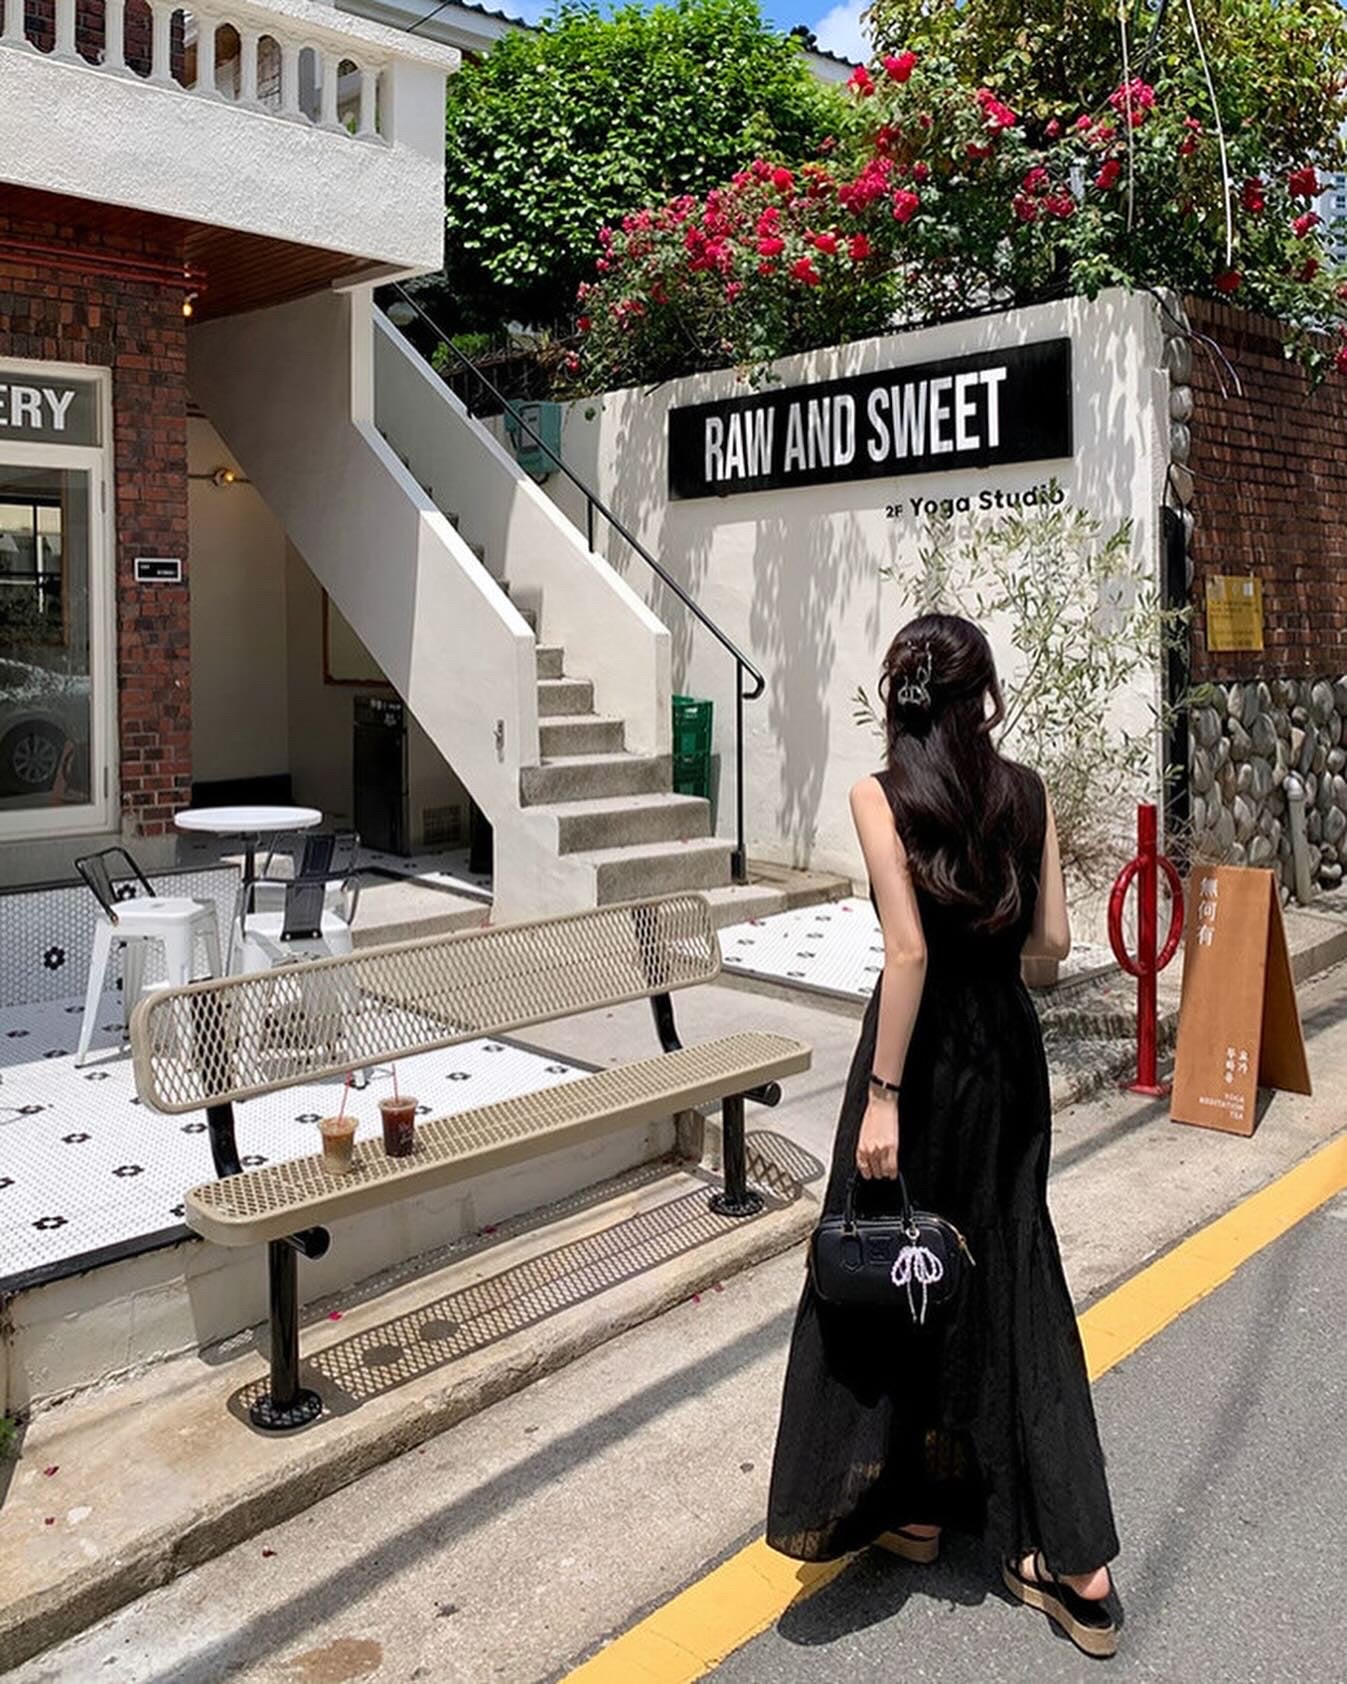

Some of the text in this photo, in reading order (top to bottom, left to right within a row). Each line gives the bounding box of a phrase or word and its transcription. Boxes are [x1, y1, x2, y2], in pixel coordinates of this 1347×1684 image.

[705, 366, 1007, 483] RAW AND SWEET
[885, 484, 1065, 520] 2F Yoga Studio
[1198, 877, 1219, 947] 無何有
